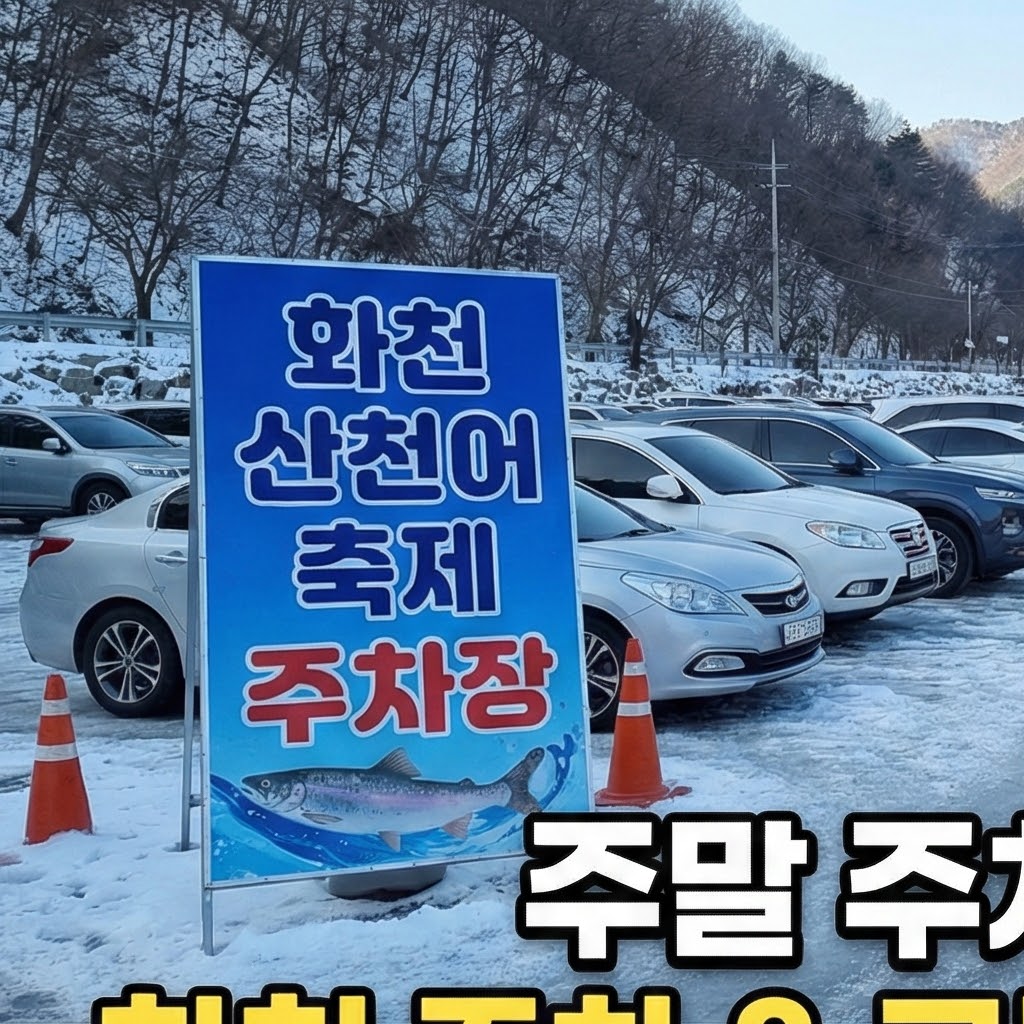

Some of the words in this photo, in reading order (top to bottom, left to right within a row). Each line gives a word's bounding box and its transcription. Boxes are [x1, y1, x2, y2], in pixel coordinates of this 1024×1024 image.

[283, 294, 489, 395] 화천
[236, 406, 542, 507] 산천어
[293, 517, 500, 621] 축제
[242, 632, 558, 748] 주차장
